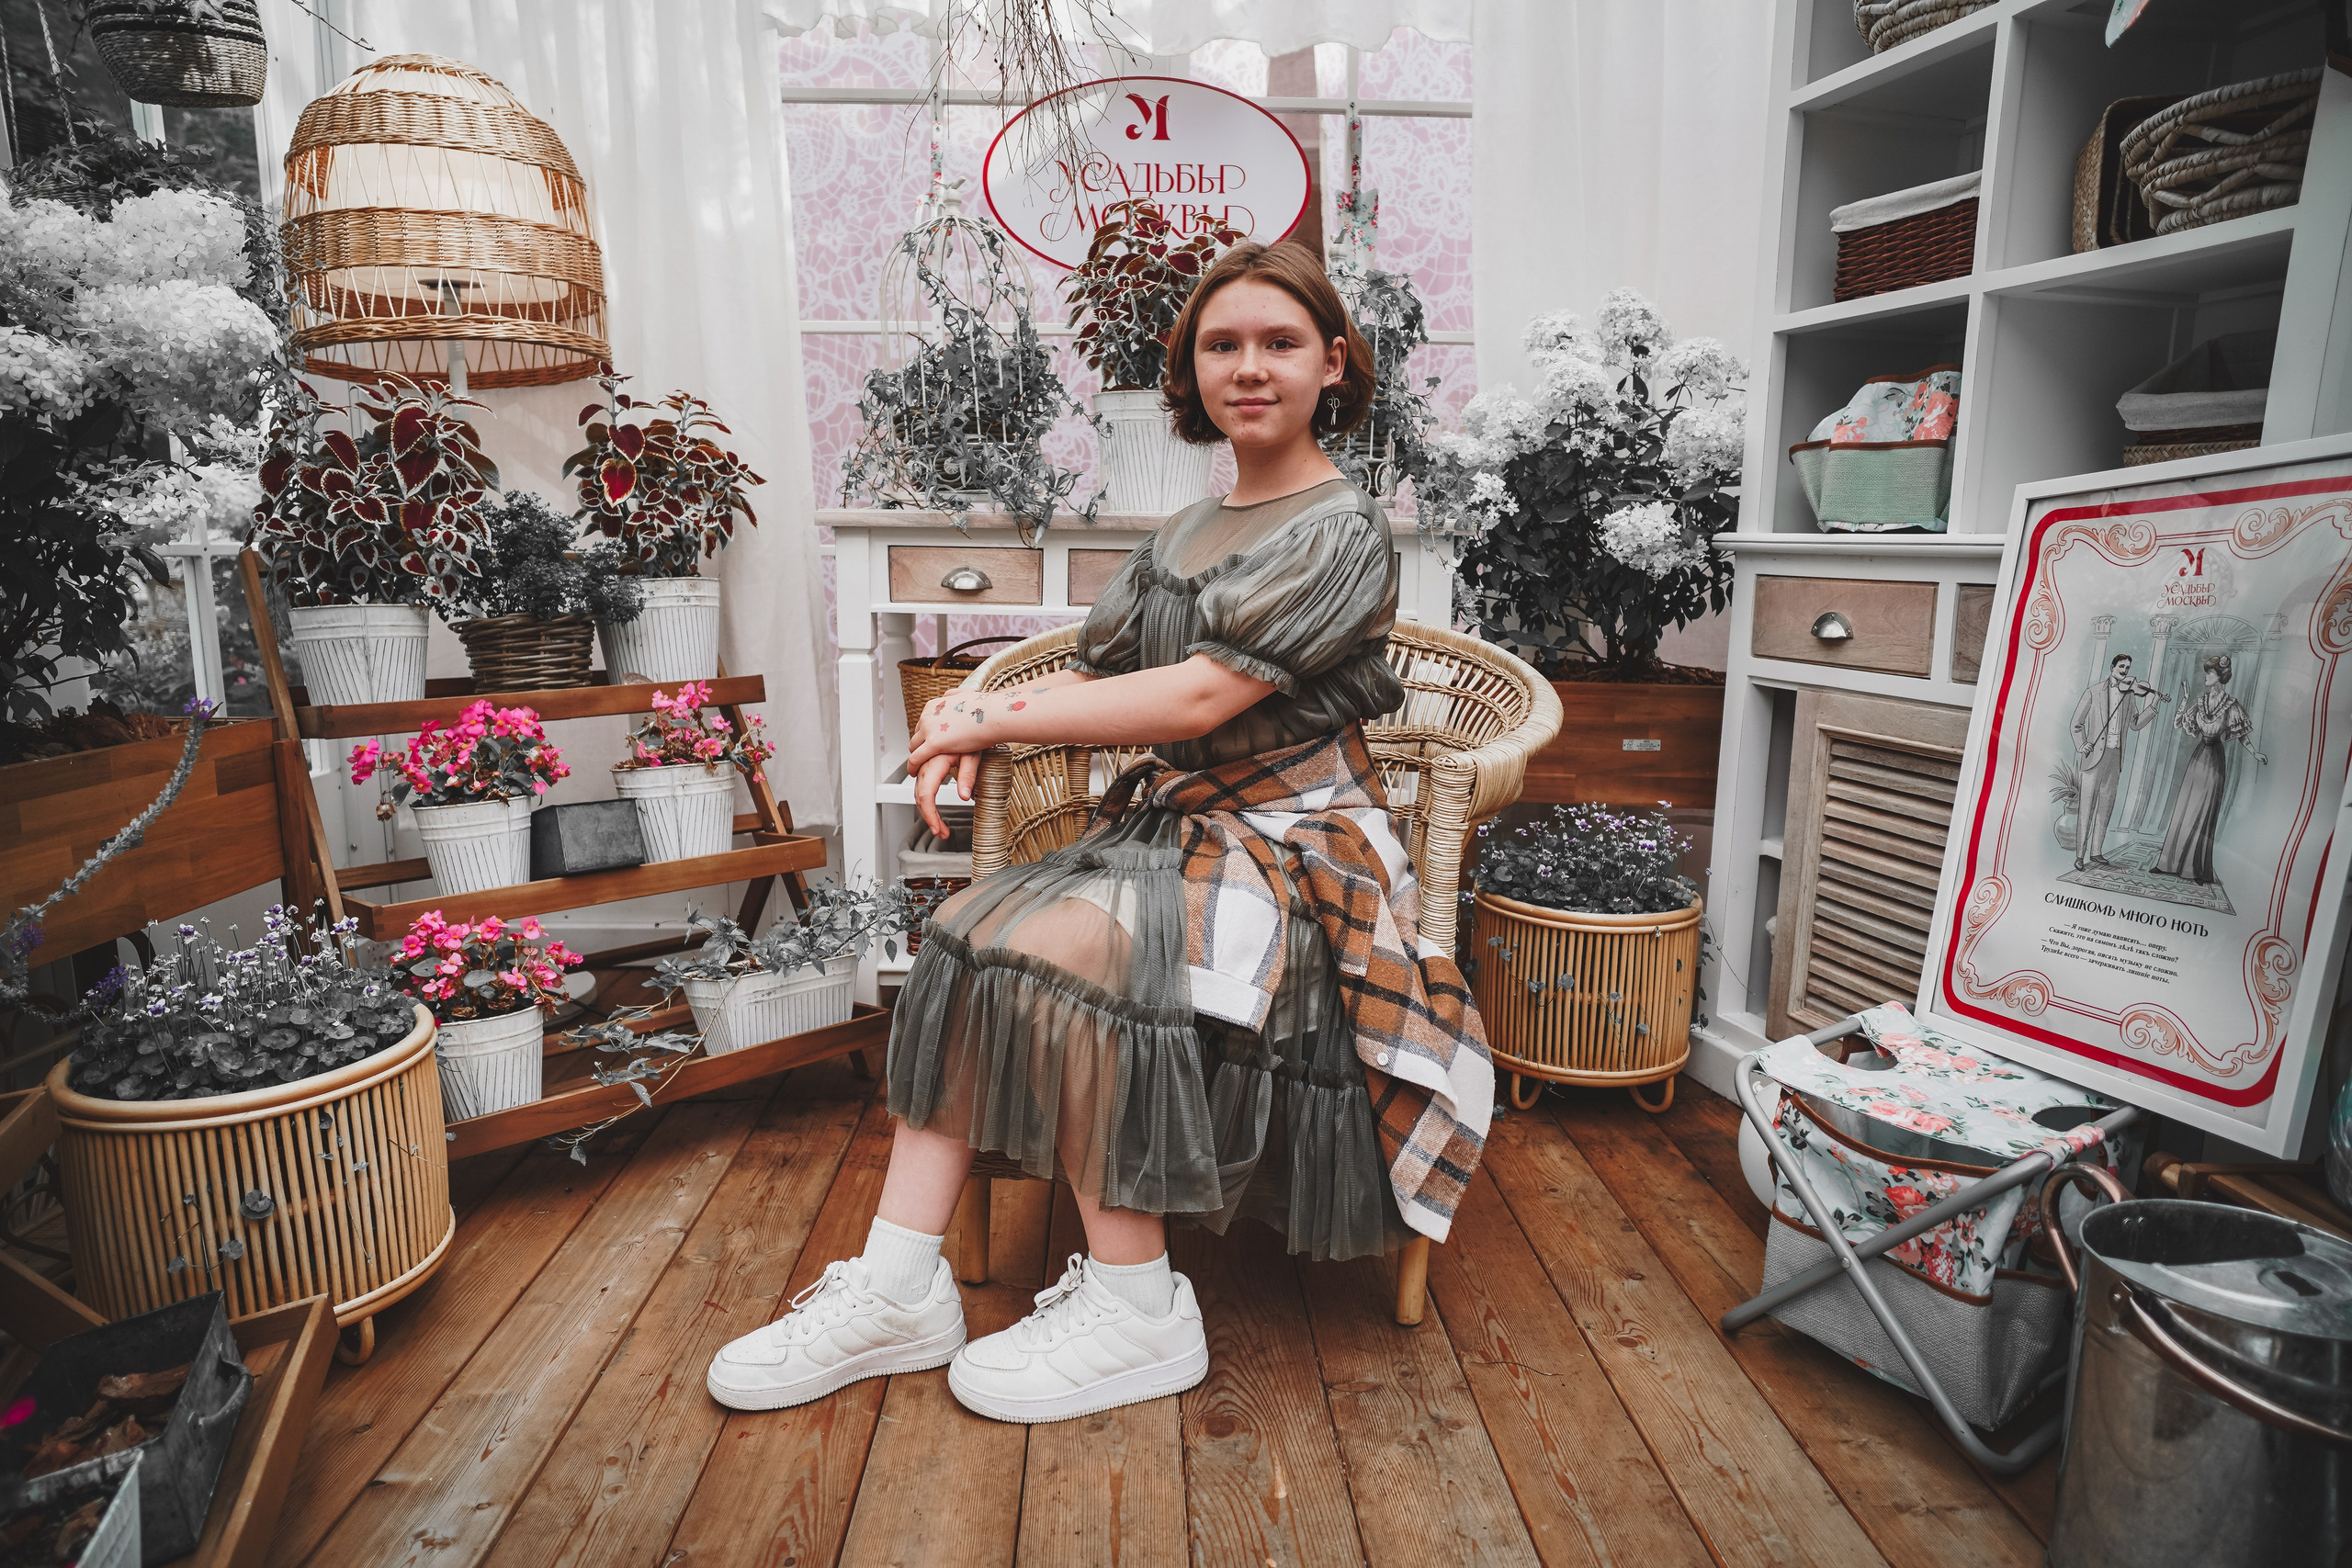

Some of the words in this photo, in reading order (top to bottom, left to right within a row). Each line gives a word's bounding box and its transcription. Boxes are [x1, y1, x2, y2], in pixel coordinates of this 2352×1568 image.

[1049, 152, 1246, 203] УСАДЬБЫ
[2156, 595, 2217, 609] МОСКВЫ
[2160, 581, 2216, 598] УСАДЬБЫ
[2044, 892, 2116, 917] СЛИШКОМЪ
[2119, 908, 2167, 928] МНОГО
[2171, 919, 2209, 937] НОТЪ
[2049, 926, 2075, 938] Скажите,
[2151, 953, 2179, 963] сложно?
[2060, 941, 2070, 949] Вы,
[2071, 945, 2096, 956] дорогая,
[2097, 952, 2118, 961] писать
[2119, 957, 2143, 968] музыку
[2153, 966, 2178, 976] сложно.
[2151, 975, 2169, 984] ноты.
